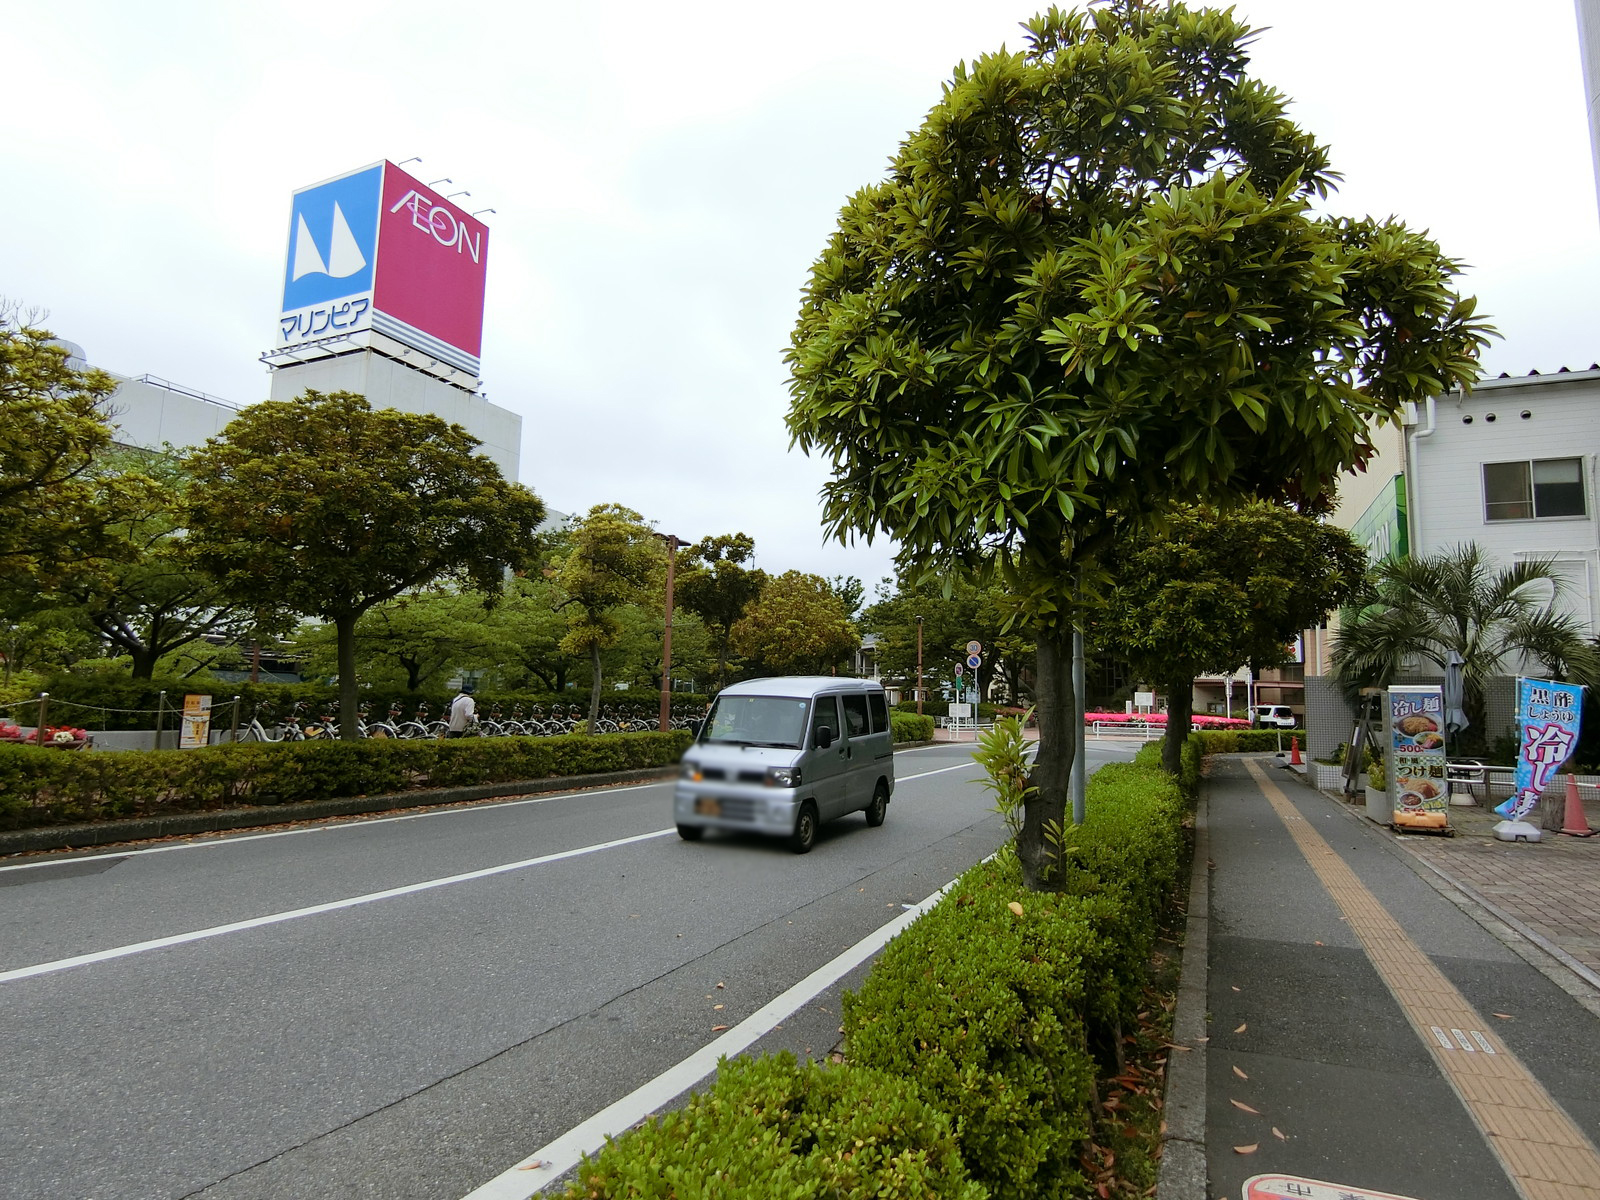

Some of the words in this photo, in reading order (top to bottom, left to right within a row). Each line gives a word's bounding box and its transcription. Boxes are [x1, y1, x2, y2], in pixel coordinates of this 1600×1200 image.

[280, 298, 369, 341] マリンピア
[970, 644, 978, 652] 30
[1393, 696, 1440, 716] 冷し麺
[1530, 687, 1574, 708] 黒酢
[1527, 706, 1574, 724] しょうゆ
[1398, 765, 1443, 778] つけ麺
